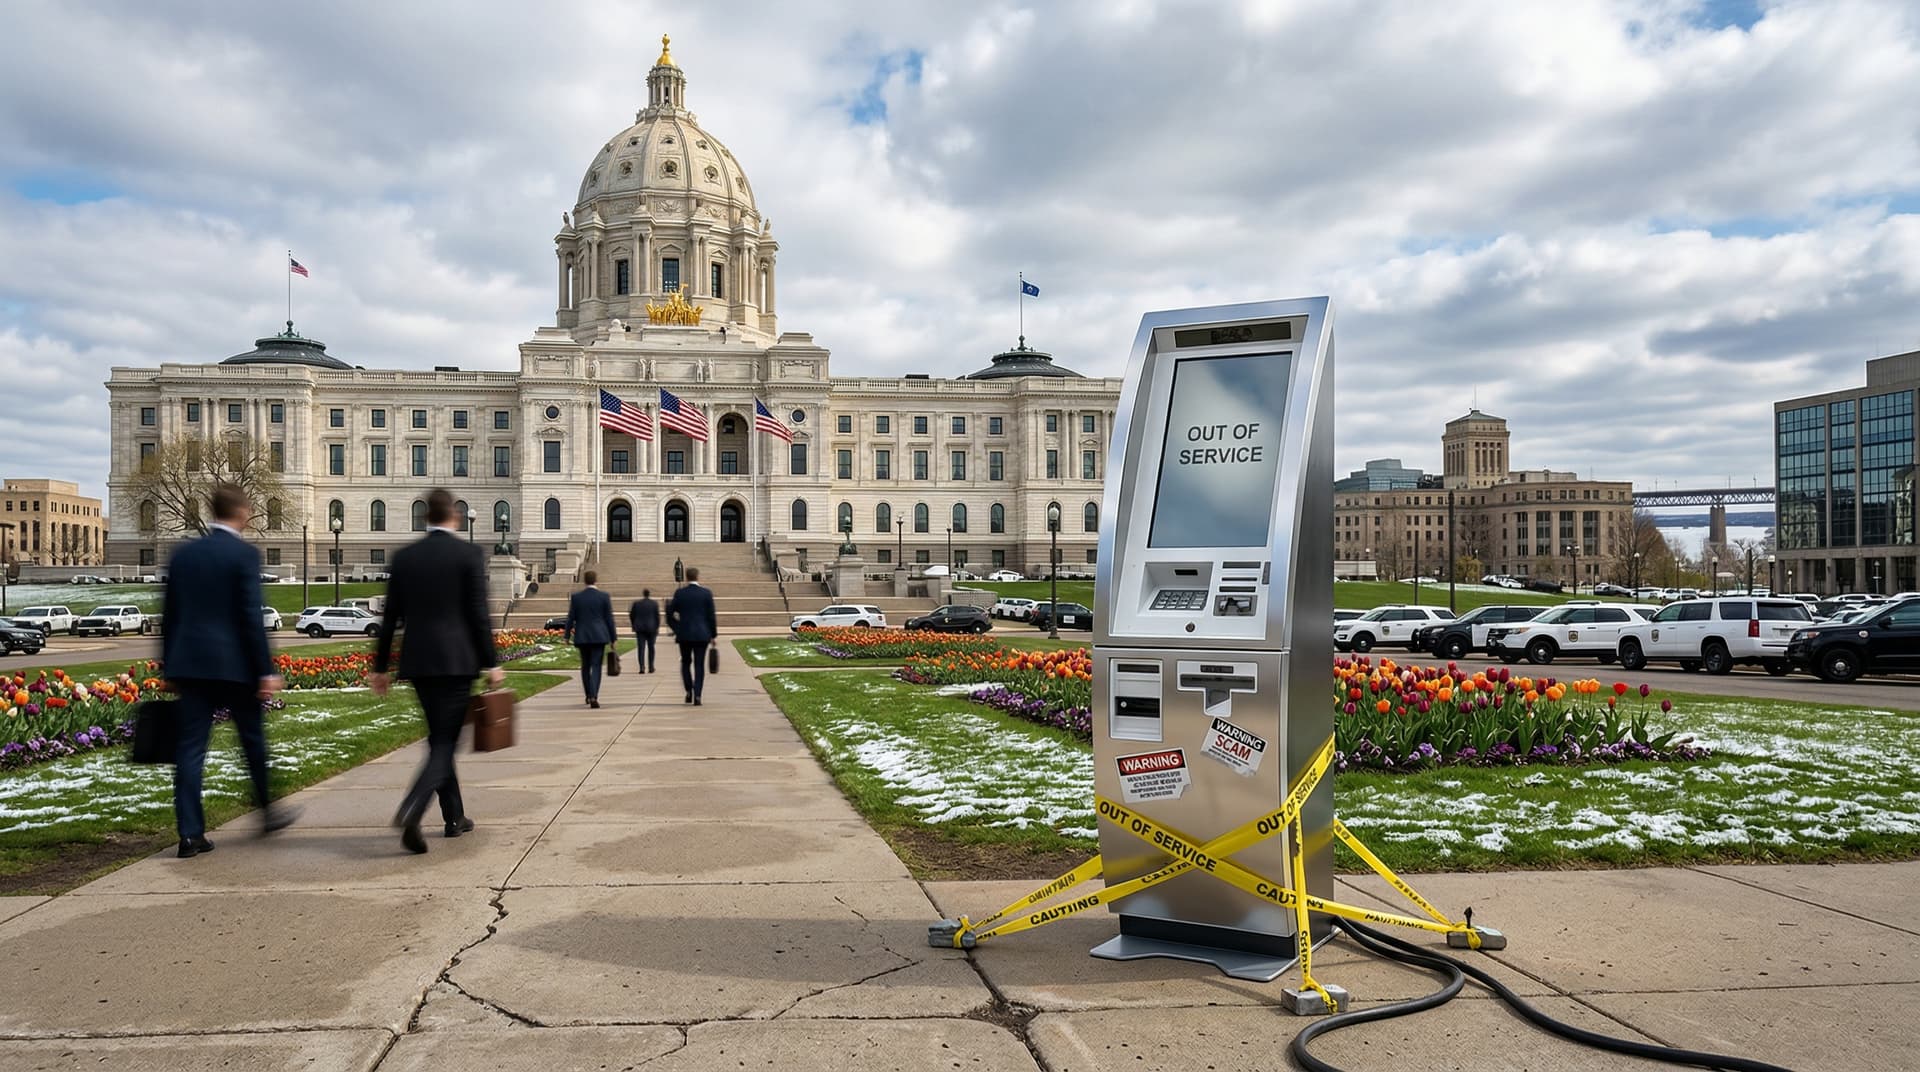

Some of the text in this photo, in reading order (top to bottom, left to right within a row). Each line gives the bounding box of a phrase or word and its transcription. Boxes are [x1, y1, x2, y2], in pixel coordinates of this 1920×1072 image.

[1187, 423, 1260, 441] OUT OF
[1179, 446, 1263, 465] SERVICE
[1216, 719, 1263, 750] WARNING
[1215, 734, 1252, 761] SCAM
[1122, 754, 1179, 772] WARNING
[1257, 811, 1285, 835] OUT
[1099, 801, 1130, 825] OUT
[1131, 819, 1152, 836] OF
[1153, 831, 1217, 872] SERVICE
